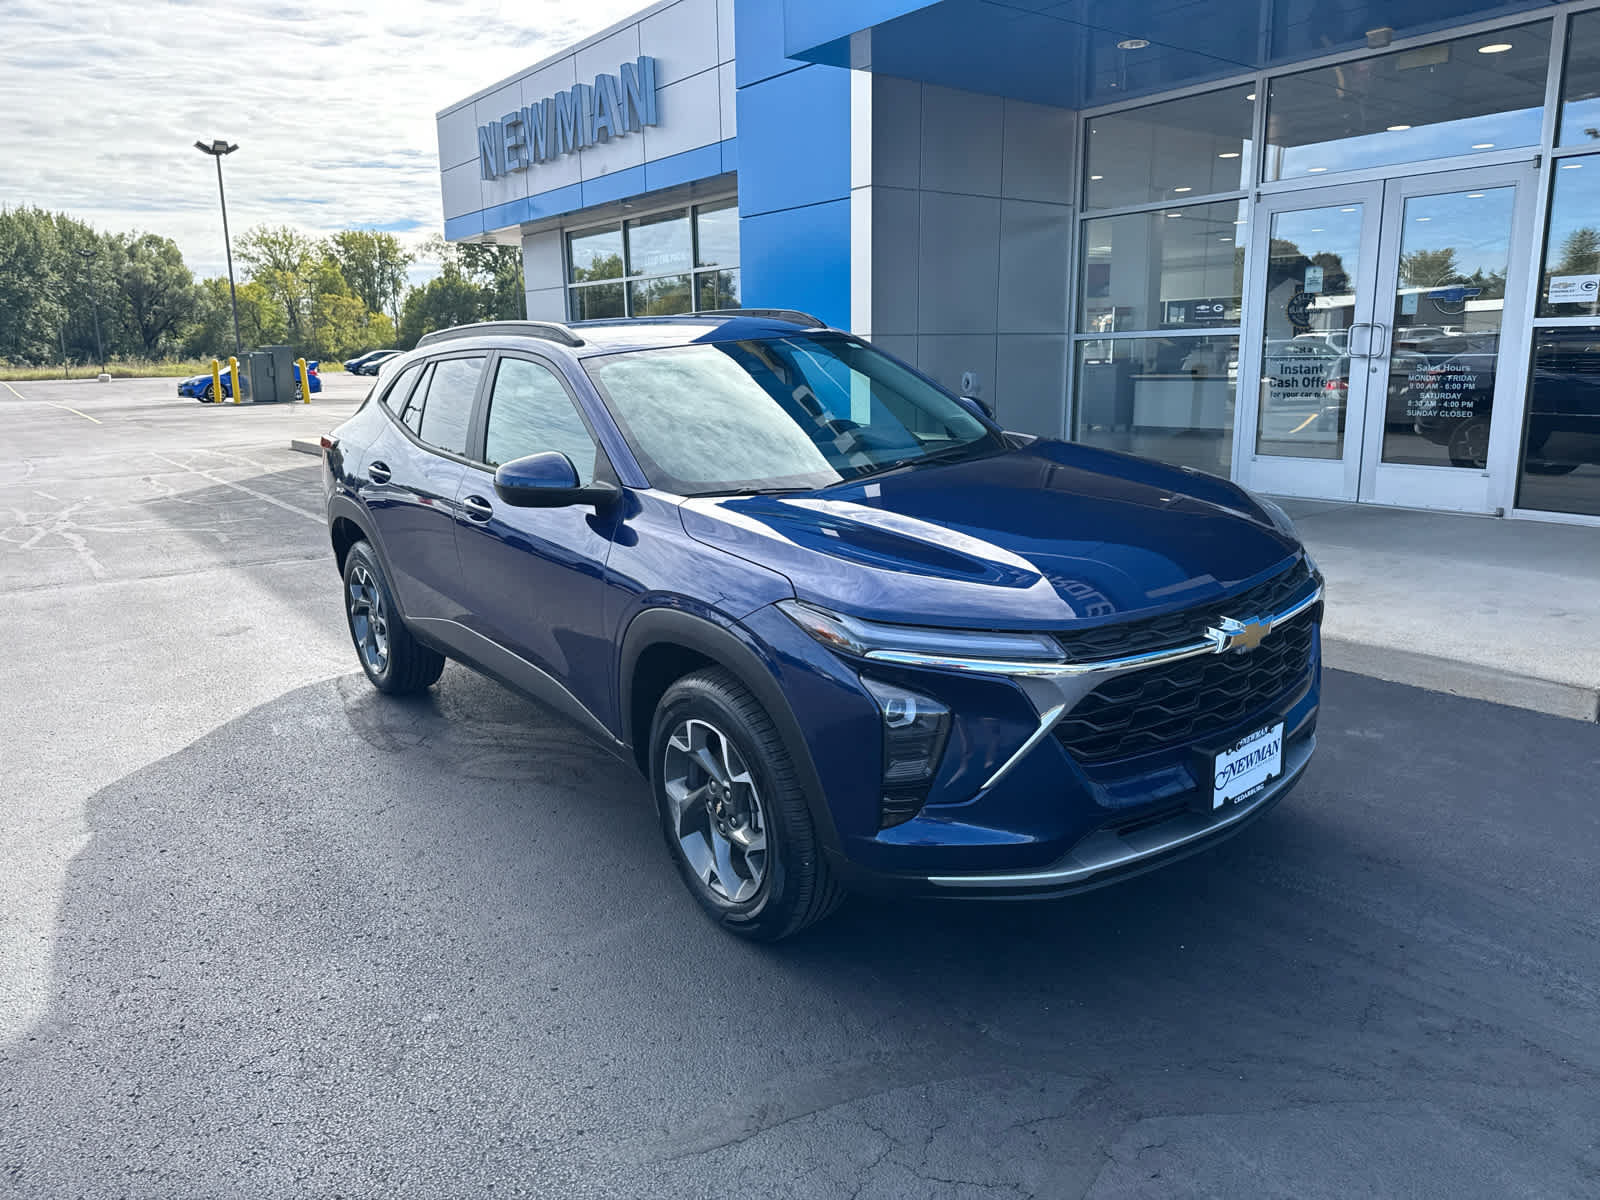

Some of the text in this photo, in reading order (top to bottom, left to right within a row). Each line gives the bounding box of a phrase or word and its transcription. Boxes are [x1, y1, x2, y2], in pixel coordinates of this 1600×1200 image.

[478, 56, 657, 180] NEWMAN
[1280, 364, 1324, 375] Instant
[1416, 364, 1471, 372] Sales Hours
[1269, 376, 1331, 388] Cash Offe
[1408, 374, 1441, 382] MONDAY
[1447, 374, 1478, 382] FRIDAY
[1282, 391, 1298, 400] your
[1419, 392, 1462, 400] SATURDAY
[1461, 400, 1474, 408] PM
[1406, 409, 1473, 418] SUNDAY CLOSED
[1214, 738, 1281, 791] NEWMAN
